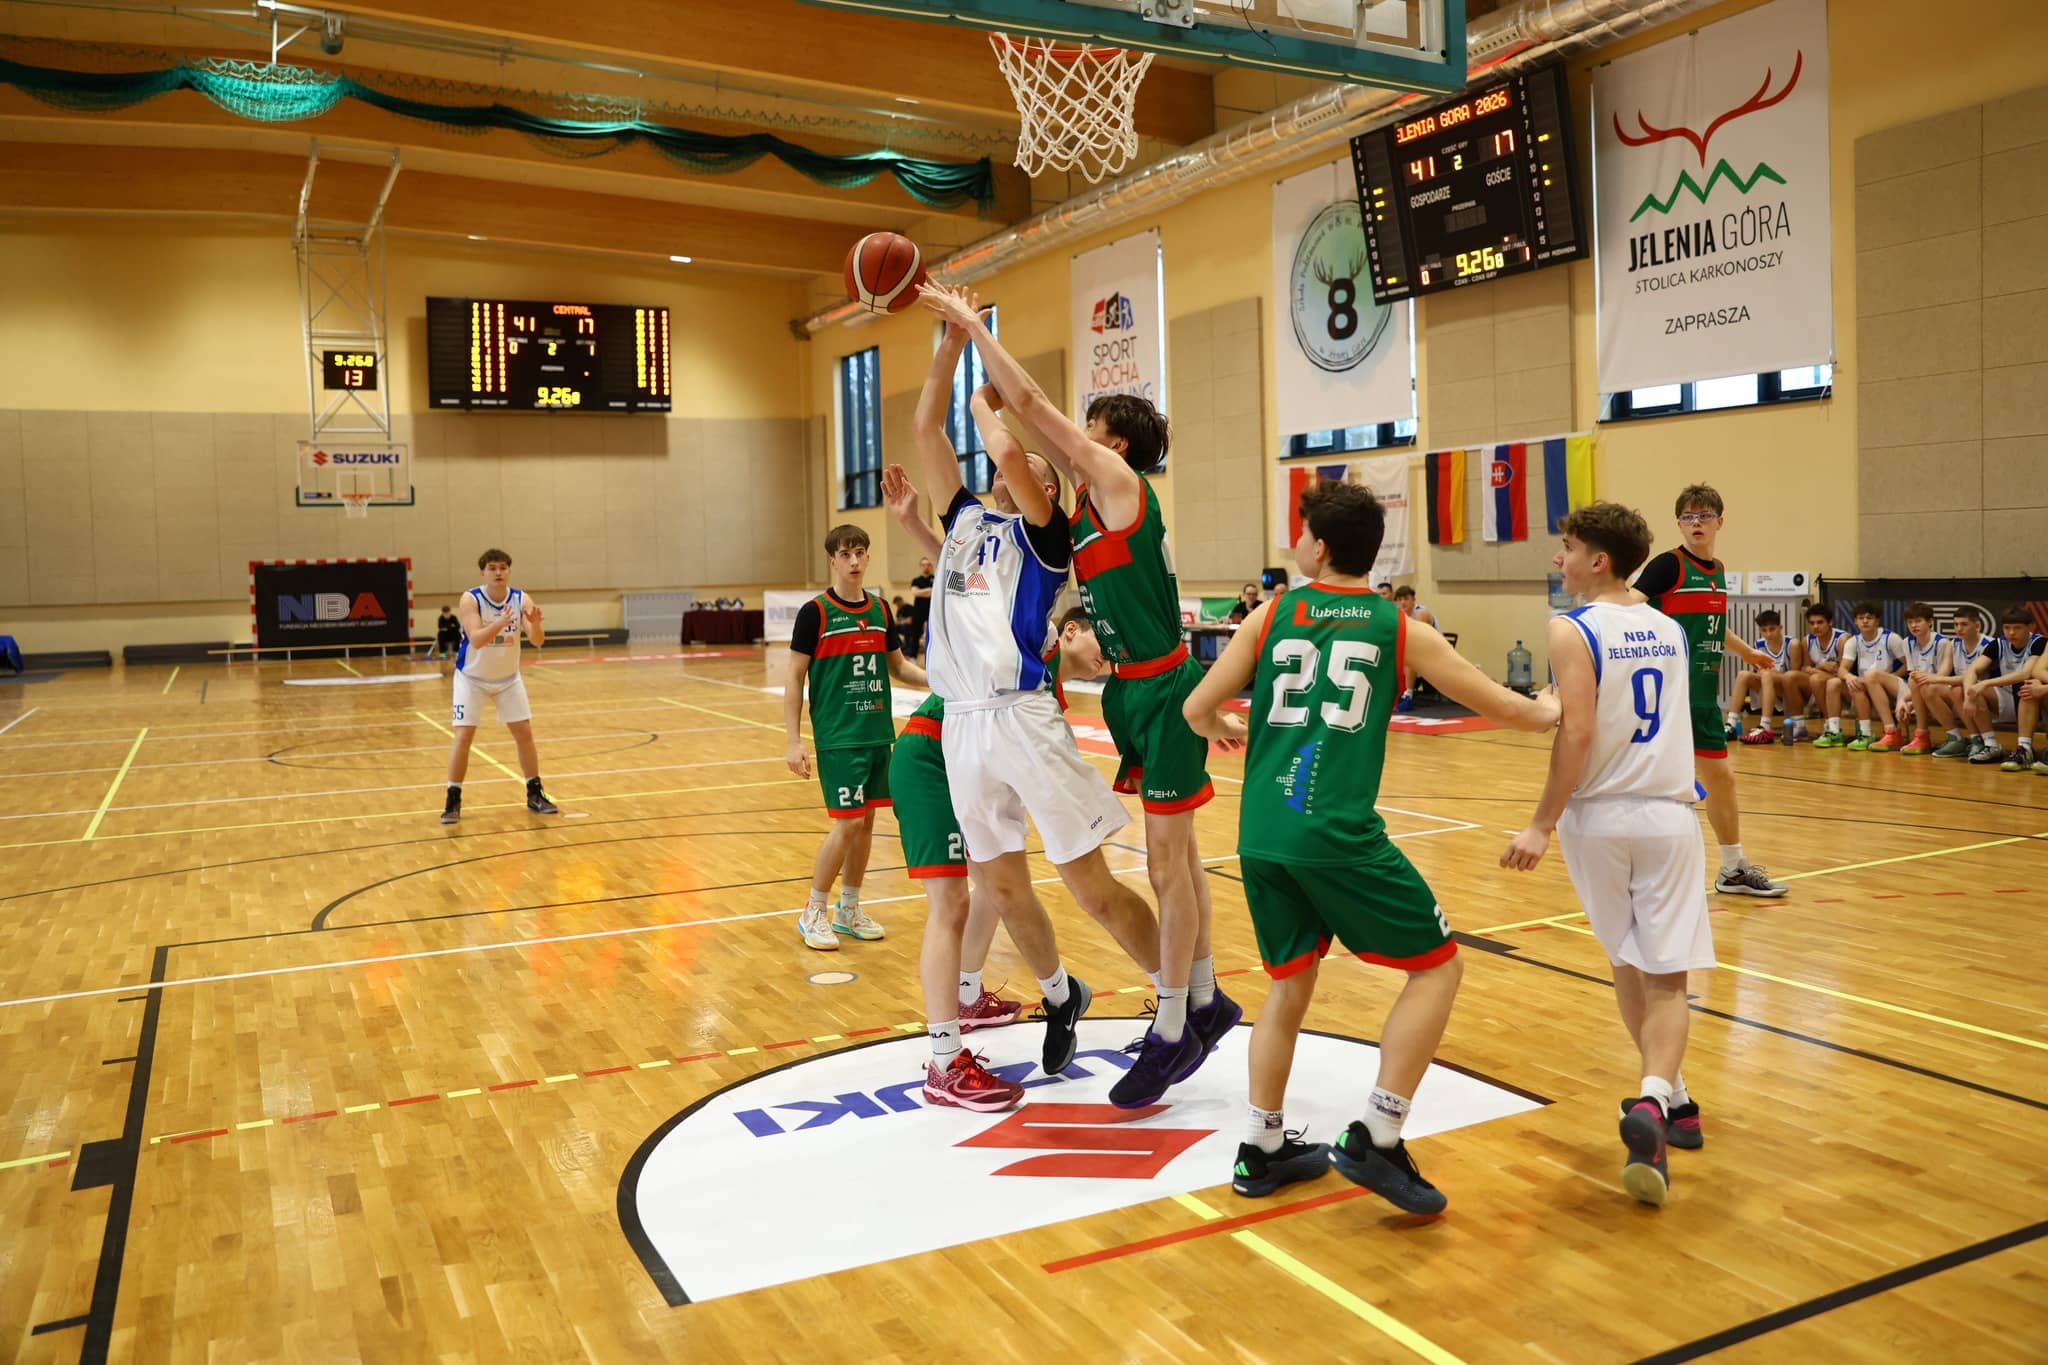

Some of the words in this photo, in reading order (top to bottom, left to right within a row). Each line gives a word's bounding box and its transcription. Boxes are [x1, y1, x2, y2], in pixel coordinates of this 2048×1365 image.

[1440, 104, 1470, 127] GORA
[1475, 90, 1507, 115] 2026
[1495, 129, 1515, 156] 17
[1410, 156, 1435, 181] 41
[1453, 154, 1463, 171] 2
[1485, 165, 1512, 187] GOŚCIE
[1410, 185, 1451, 209] GOSPODARZE
[1628, 219, 1716, 273] JELENIA
[1722, 201, 1791, 250] GÓRA
[1635, 272, 1686, 294] STOLICA
[1689, 251, 1784, 284] KARKONOSZY
[1327, 278, 1358, 341] 8
[1665, 305, 1751, 335] ZAPRASZA
[513, 316, 536, 332] 41
[579, 318, 594, 334] 17
[547, 342, 557, 356] 2
[1093, 336, 1137, 366] SPORT
[345, 369, 363, 386] 13
[1091, 364, 1140, 390] KOCHA
[333, 453, 400, 464] SUZUKI
[277, 592, 387, 621] NBA
[1624, 630, 1657, 642] NBA
[1608, 646, 1650, 660] JELENIA
[1651, 641, 1677, 657] GÓRA
[853, 654, 877, 676] 24
[1267, 638, 1381, 734] 25
[1630, 667, 1663, 743] 9
[838, 785, 864, 807] 24
